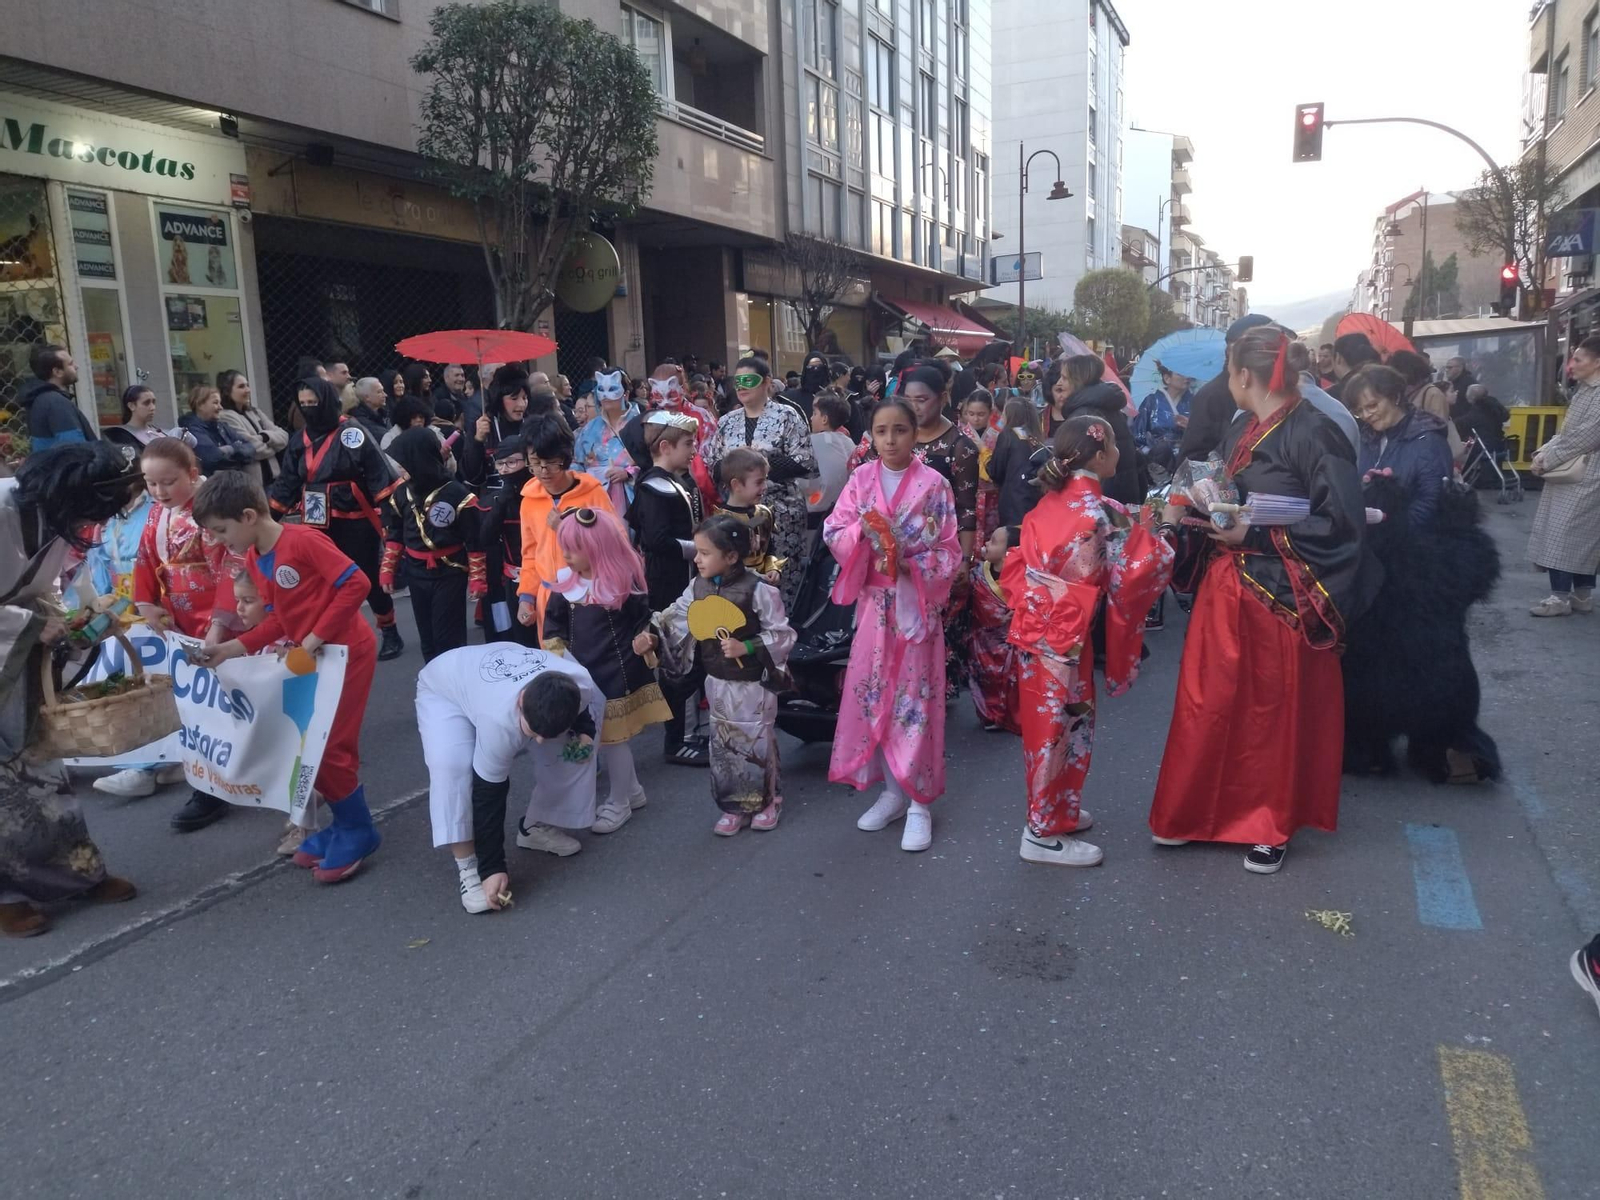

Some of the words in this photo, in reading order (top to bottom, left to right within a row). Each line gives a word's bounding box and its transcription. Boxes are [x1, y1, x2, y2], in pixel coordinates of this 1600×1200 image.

[1, 118, 196, 182] Mascotas
[69, 197, 106, 210] ADVANCE
[74, 229, 110, 241] ADVANCE
[164, 220, 224, 239] ADVANCE
[1550, 233, 1583, 252] AXA
[78, 262, 115, 273] ADVANCE
